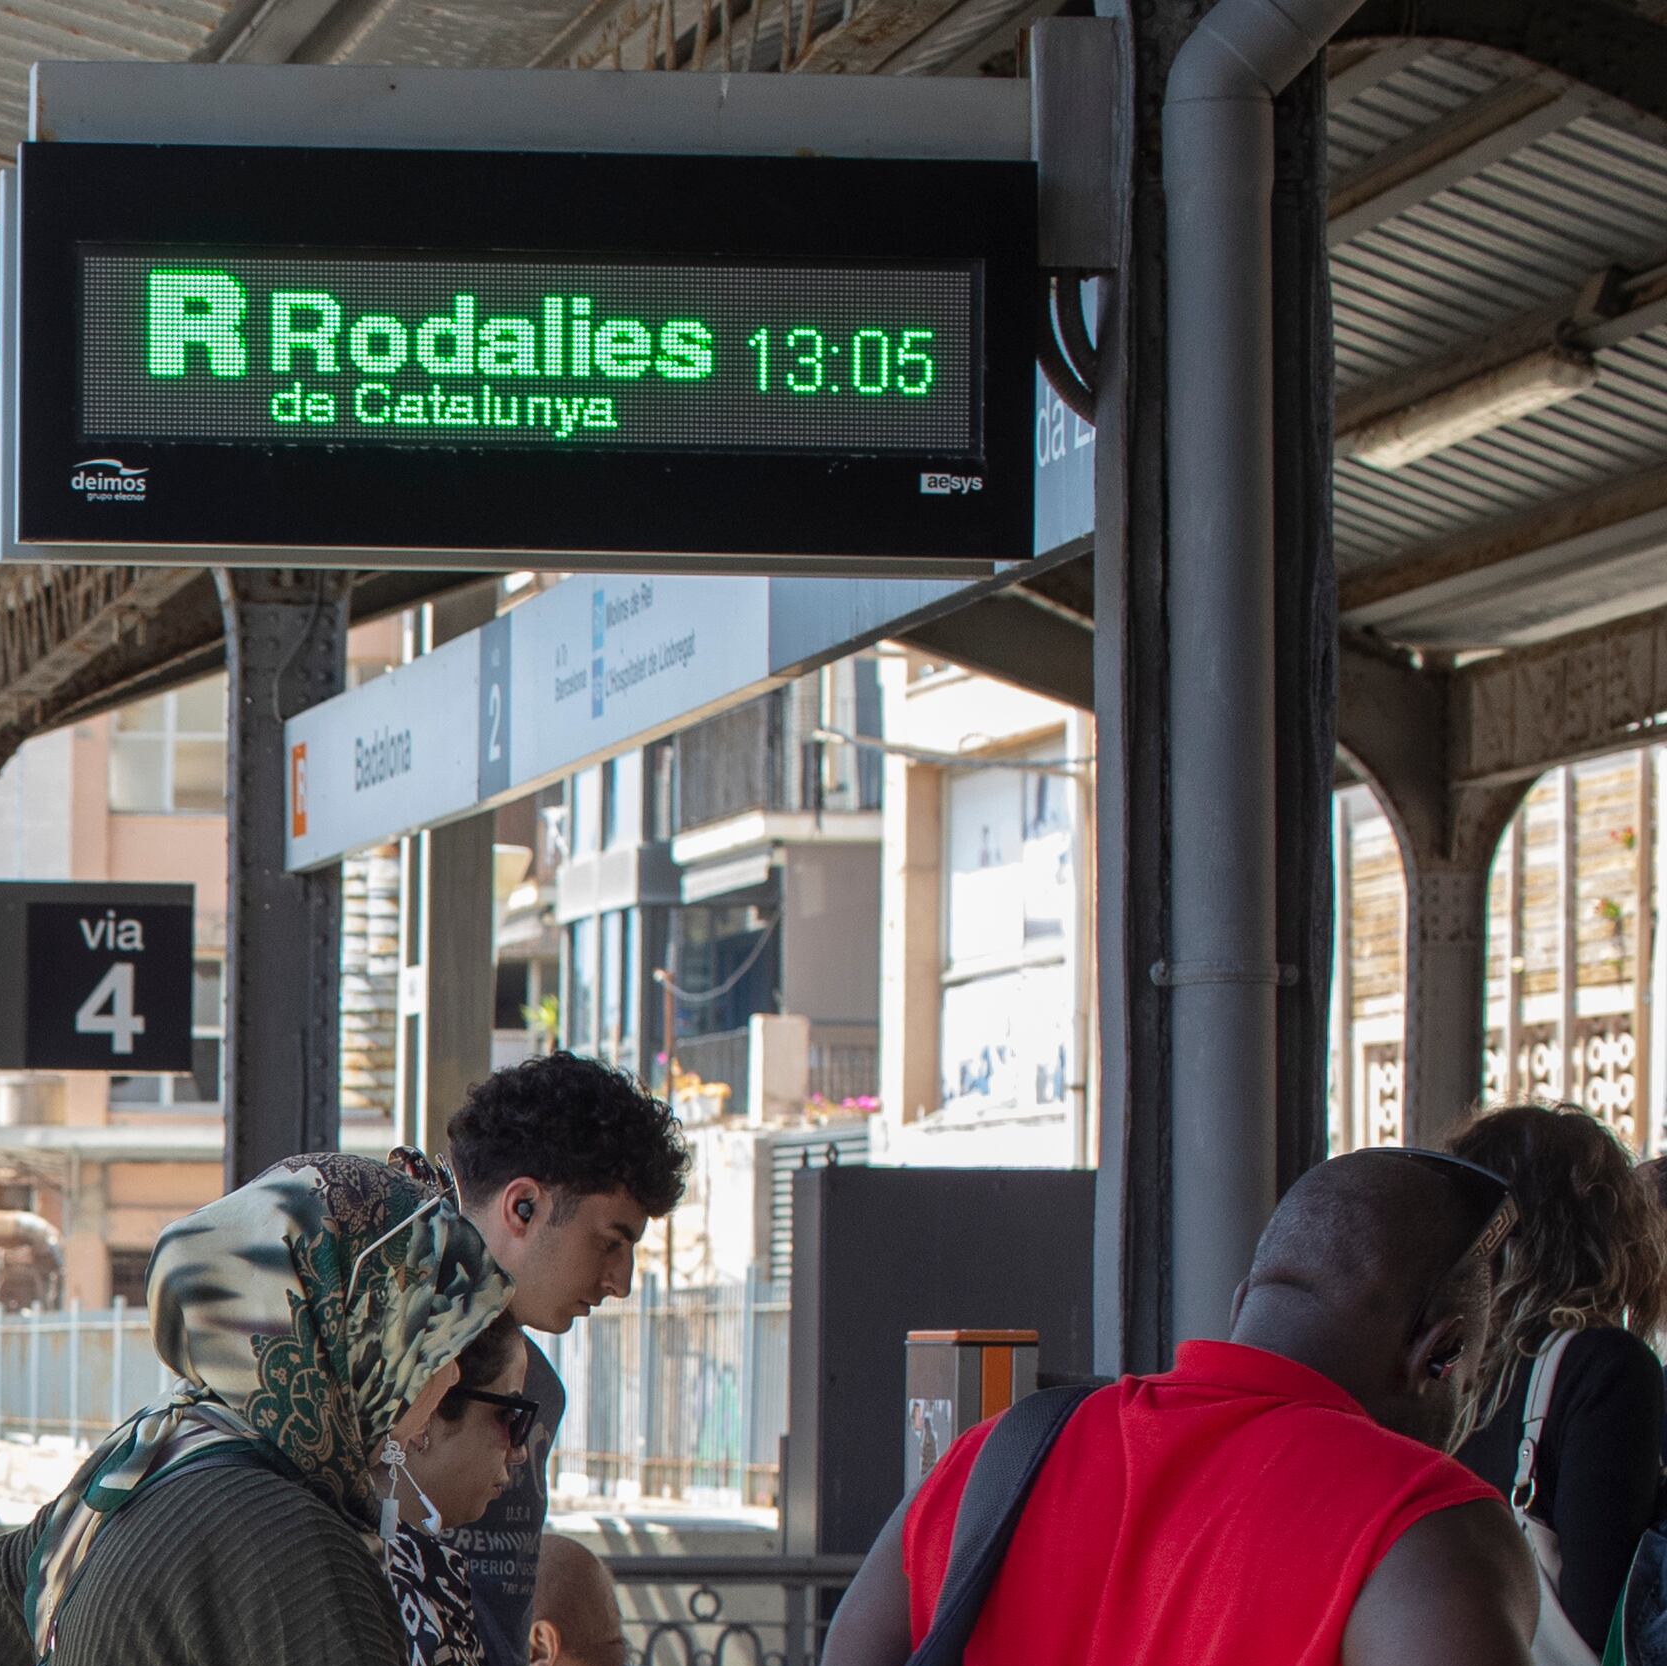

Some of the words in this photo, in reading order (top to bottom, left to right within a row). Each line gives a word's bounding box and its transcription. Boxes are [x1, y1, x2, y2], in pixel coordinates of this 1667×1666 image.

[149, 269, 247, 377] R
[271, 292, 713, 378] Rodalies
[748, 327, 933, 394] 13:05
[271, 381, 335, 424] de
[354, 382, 618, 438] Catalunya
[71, 471, 146, 492] deimos
[925, 474, 984, 495] aesys
[488, 683, 502, 763] 2
[355, 725, 411, 792] Badalona
[80, 910, 145, 952] via
[75, 962, 145, 1054] 4
